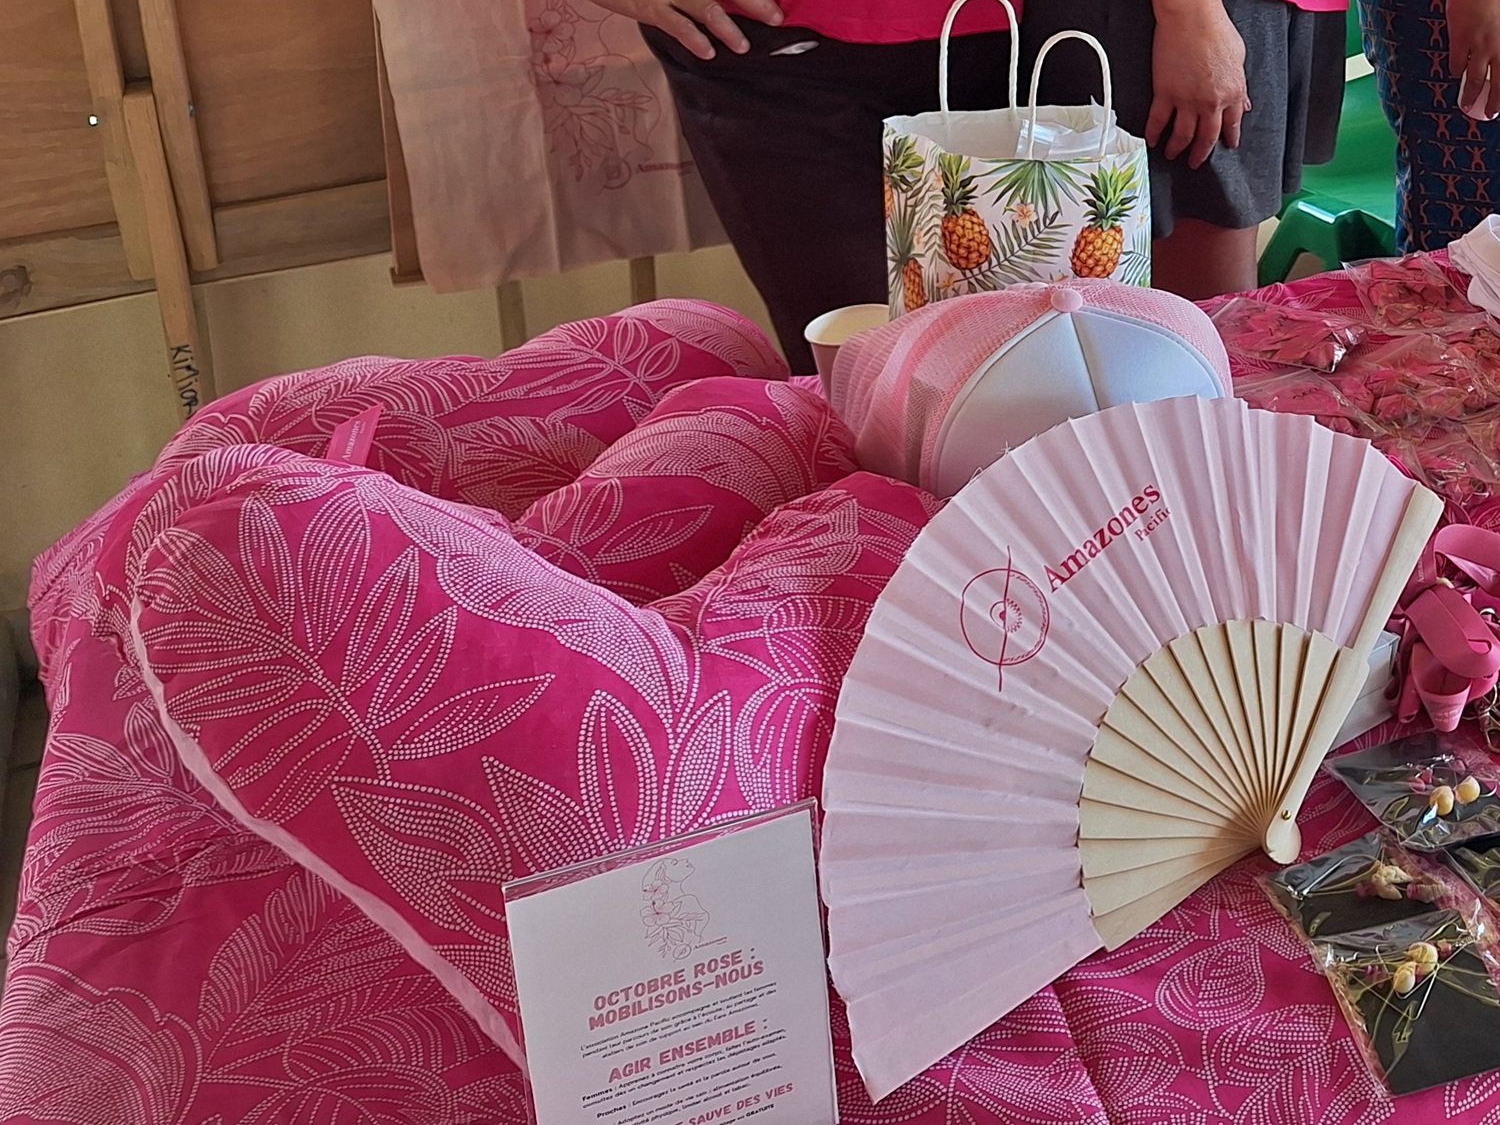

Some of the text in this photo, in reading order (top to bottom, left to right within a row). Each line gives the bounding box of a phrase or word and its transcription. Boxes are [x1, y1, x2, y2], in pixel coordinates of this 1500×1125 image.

[1044, 484, 1161, 593] Amazones
[1134, 507, 1171, 542] Pacific
[588, 960, 764, 1031] MOBILISONS-NOUS
[593, 947, 756, 1011] OCTOBRE ROSE :
[608, 1018, 768, 1084] AGIR ENSEMBLE :
[582, 1088, 613, 1102] Femmes
[596, 1104, 627, 1119] Proches
[688, 1104, 732, 1125] SAUVE
[736, 1094, 761, 1111] DES
[765, 1083, 793, 1100] VIES
